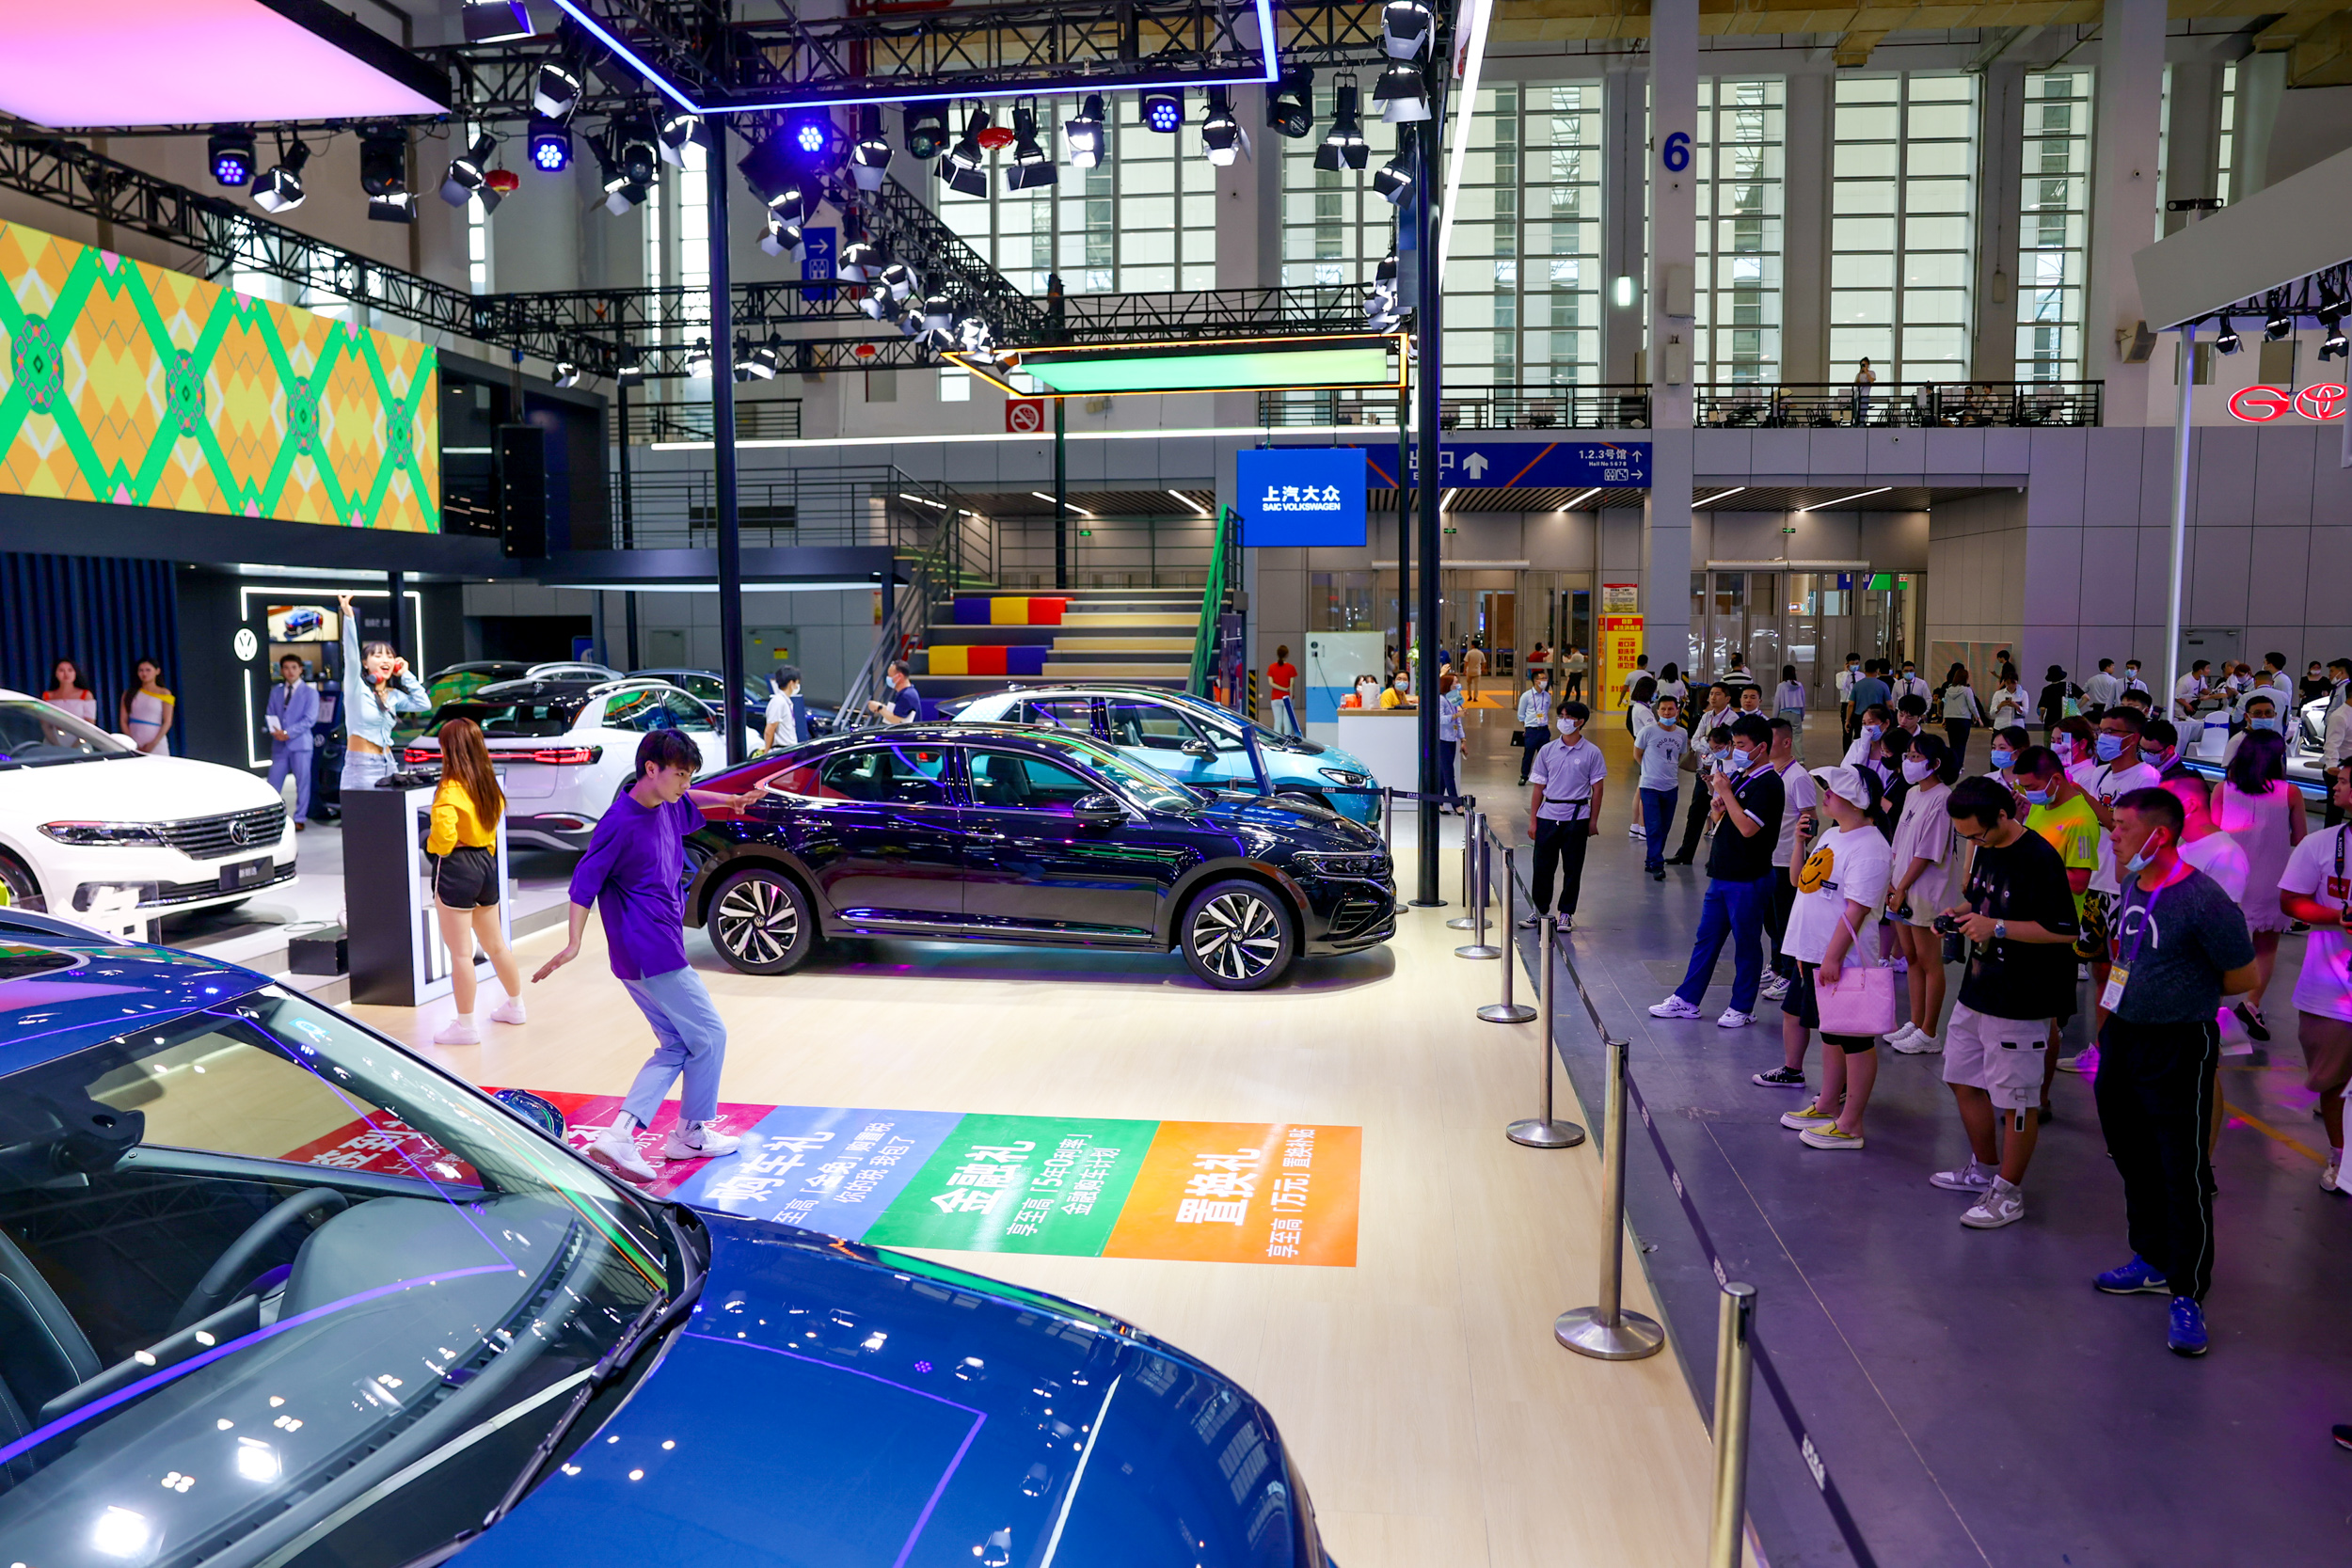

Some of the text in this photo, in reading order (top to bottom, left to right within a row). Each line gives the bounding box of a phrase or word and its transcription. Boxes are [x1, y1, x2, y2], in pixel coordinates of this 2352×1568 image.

[1663, 132, 1691, 172] 6
[1579, 448, 1628, 460] 1.2.3号馆
[1262, 485, 1341, 502] 上汽大众
[1262, 502, 1342, 512] SAIC VOLKSWAGEN
[1657, 737, 1668, 749] POLO
[706, 1132, 835, 1202] 购车礼
[930, 1140, 1036, 1215] 金融礼
[1061, 1147, 1121, 1216] 金融购车计划
[1176, 1148, 1261, 1226] 置换礼
